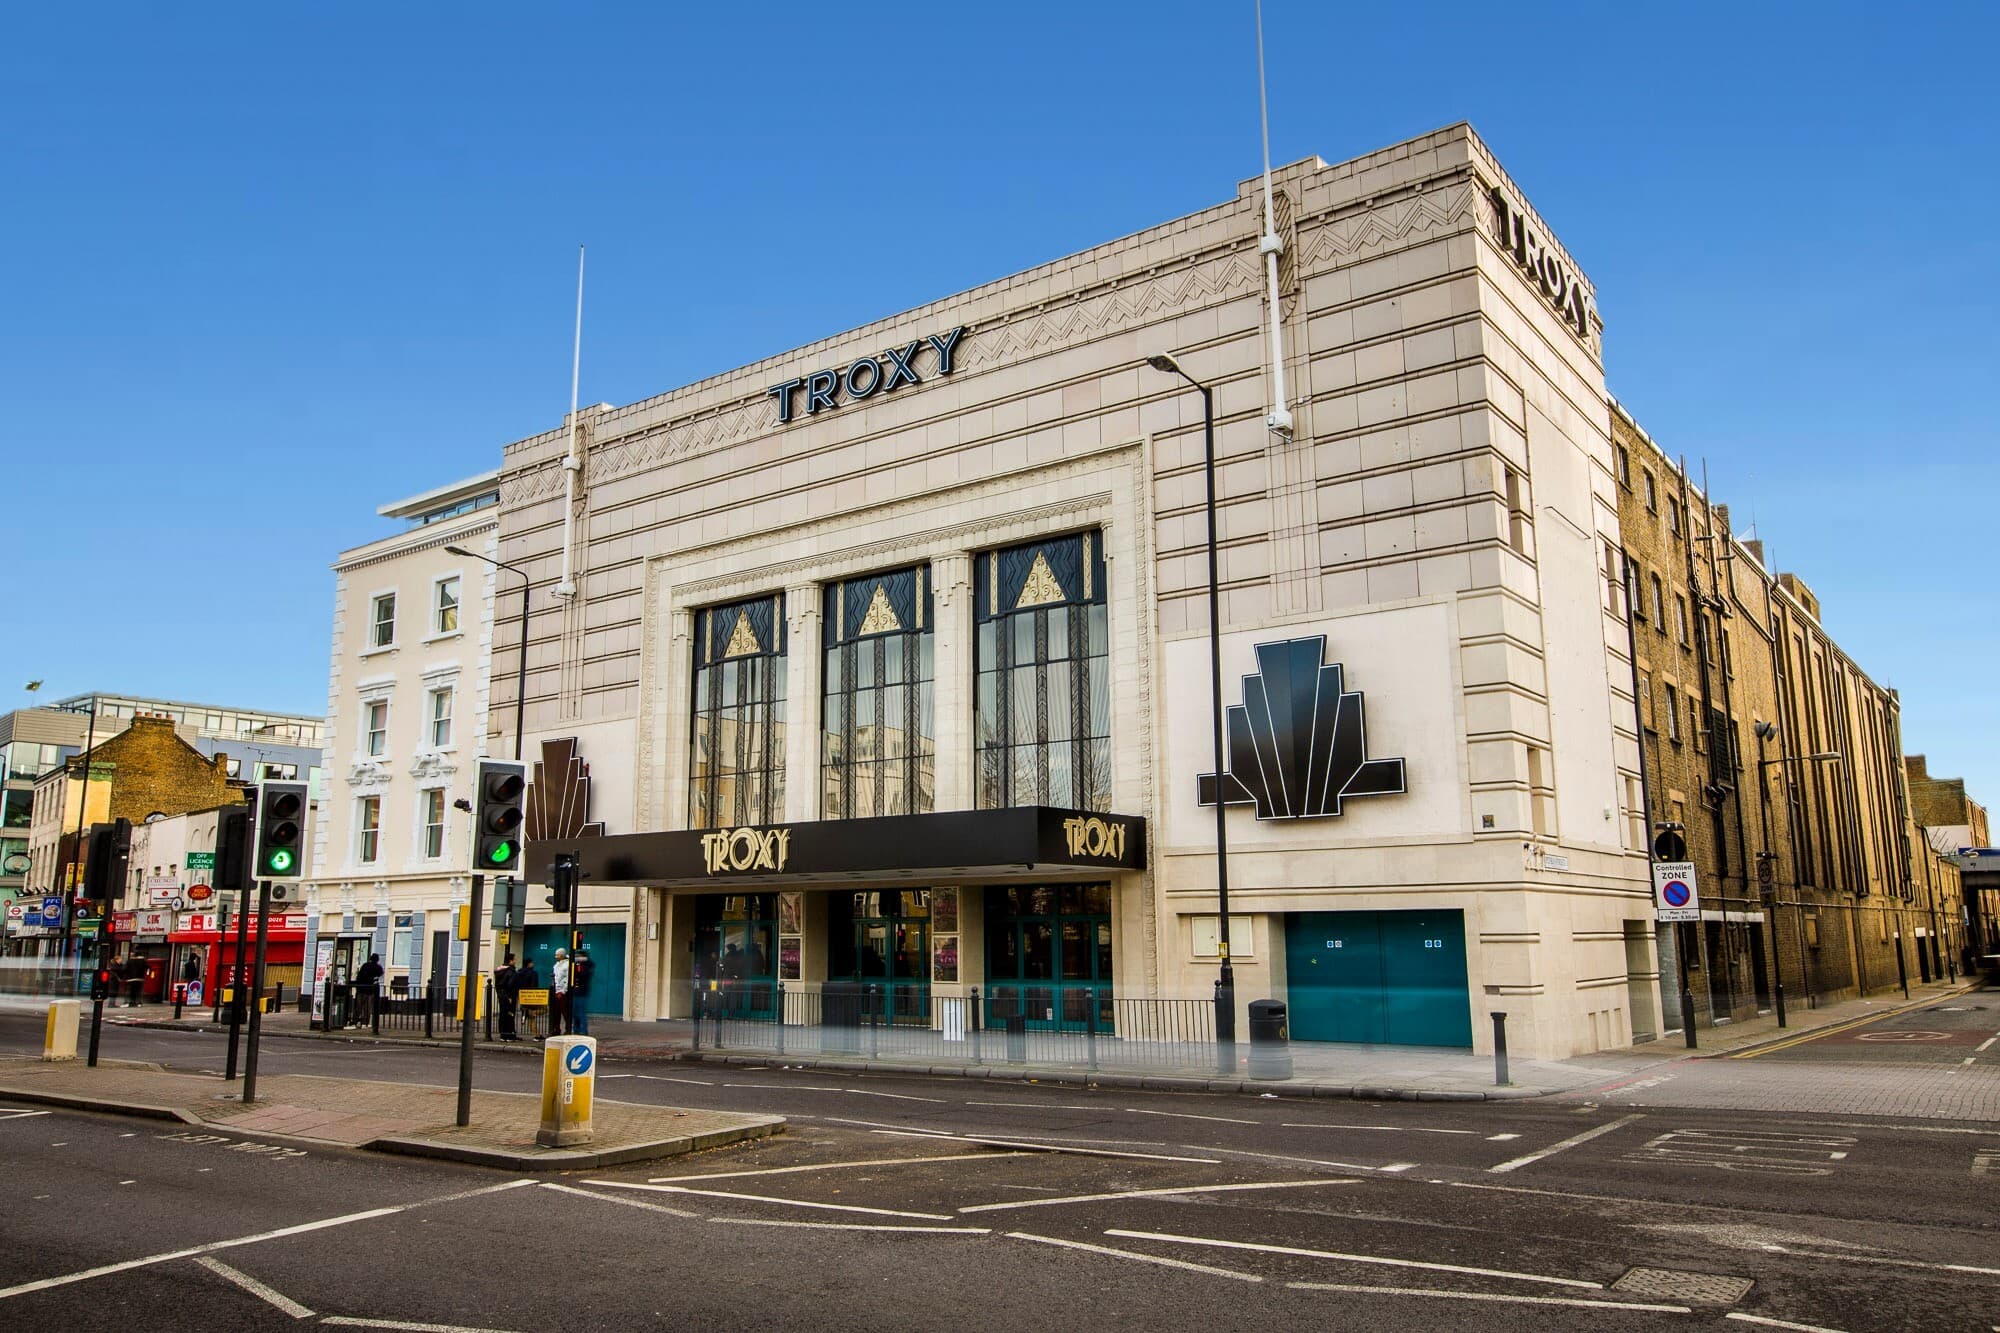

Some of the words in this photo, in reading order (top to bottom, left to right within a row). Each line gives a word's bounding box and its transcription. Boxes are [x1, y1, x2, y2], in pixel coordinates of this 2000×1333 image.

[1490, 186, 1597, 338] TROXY
[768, 326, 965, 422] TROXY
[700, 827, 791, 876] TROXY
[1063, 816, 1126, 861] TROXY
